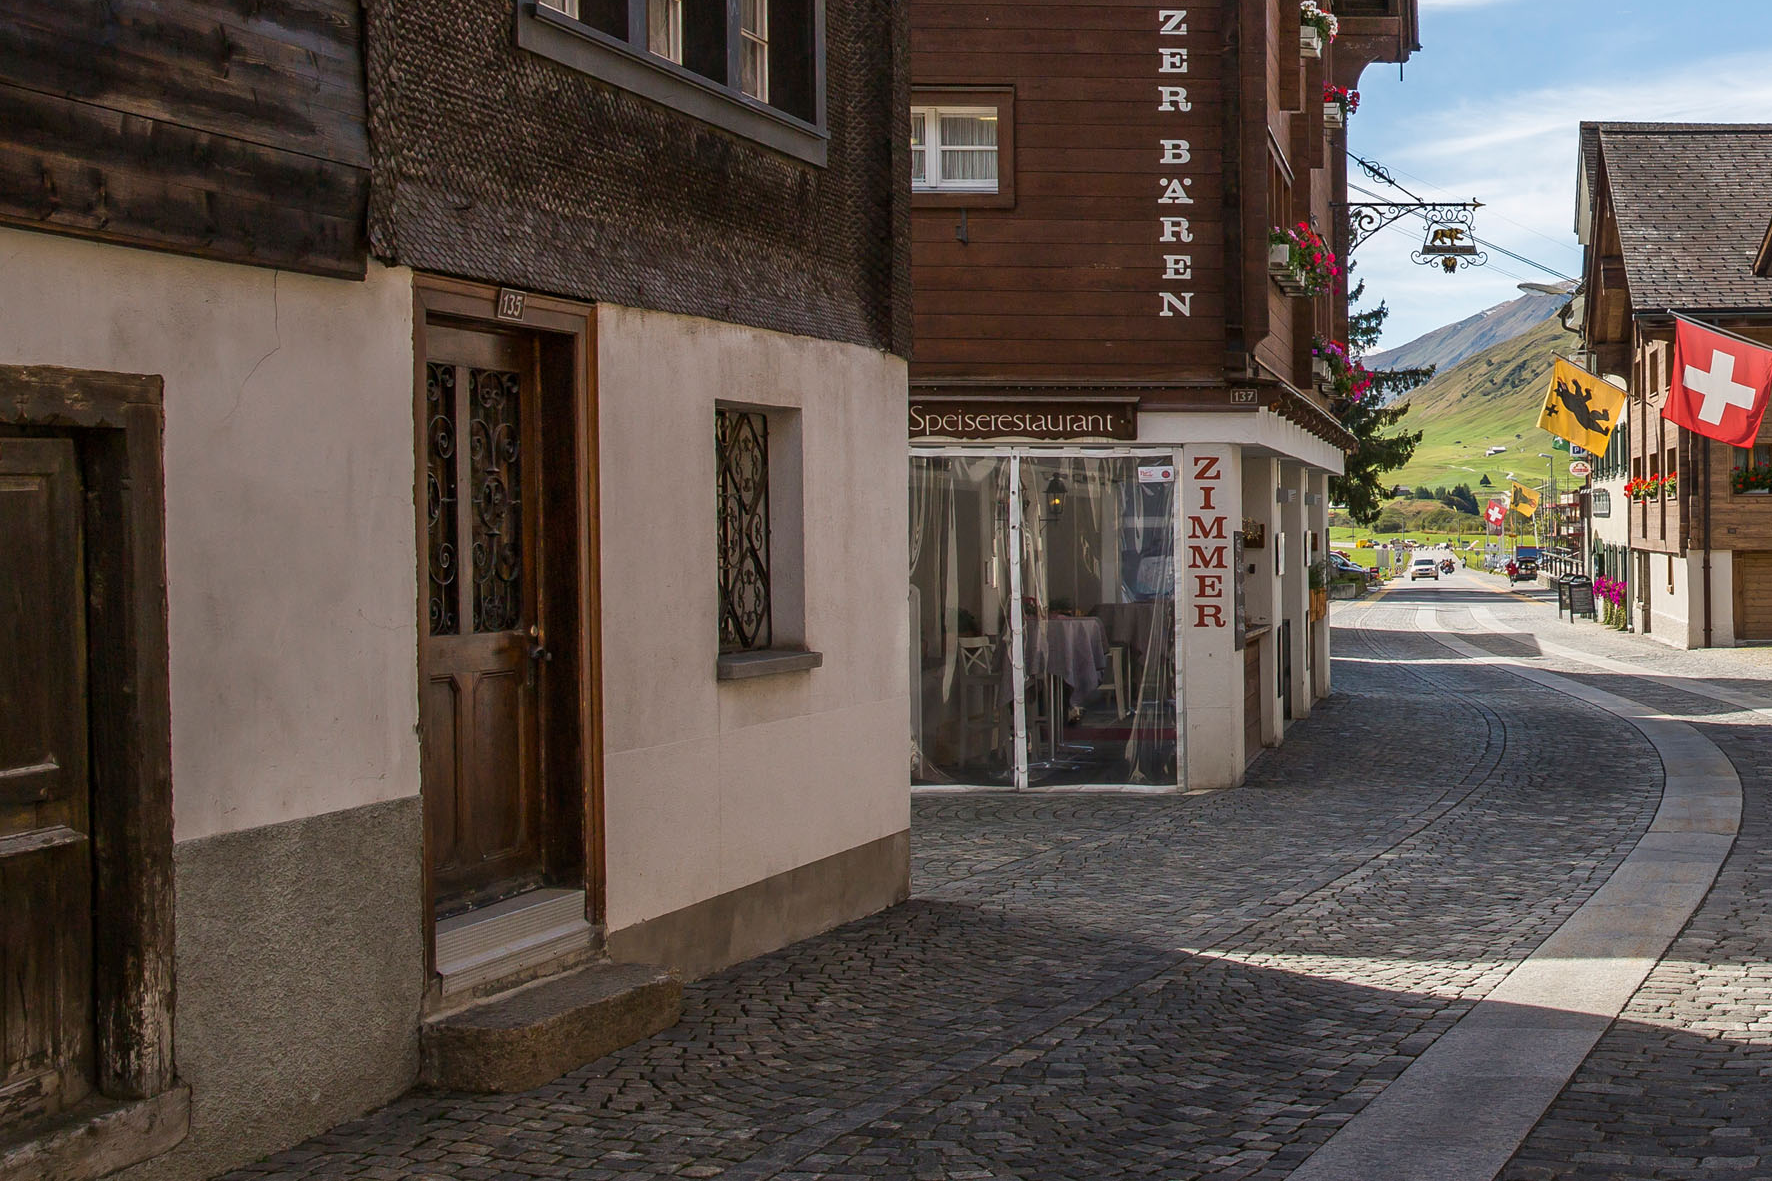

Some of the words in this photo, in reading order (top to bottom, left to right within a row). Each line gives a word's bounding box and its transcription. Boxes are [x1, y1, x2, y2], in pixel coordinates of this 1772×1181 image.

[1157, 139, 1195, 317] BÄREN
[503, 293, 523, 317] 135
[1233, 390, 1254, 402] 137
[909, 405, 1113, 436] Speiserestaurant
[1187, 456, 1228, 628] ZIMMER
